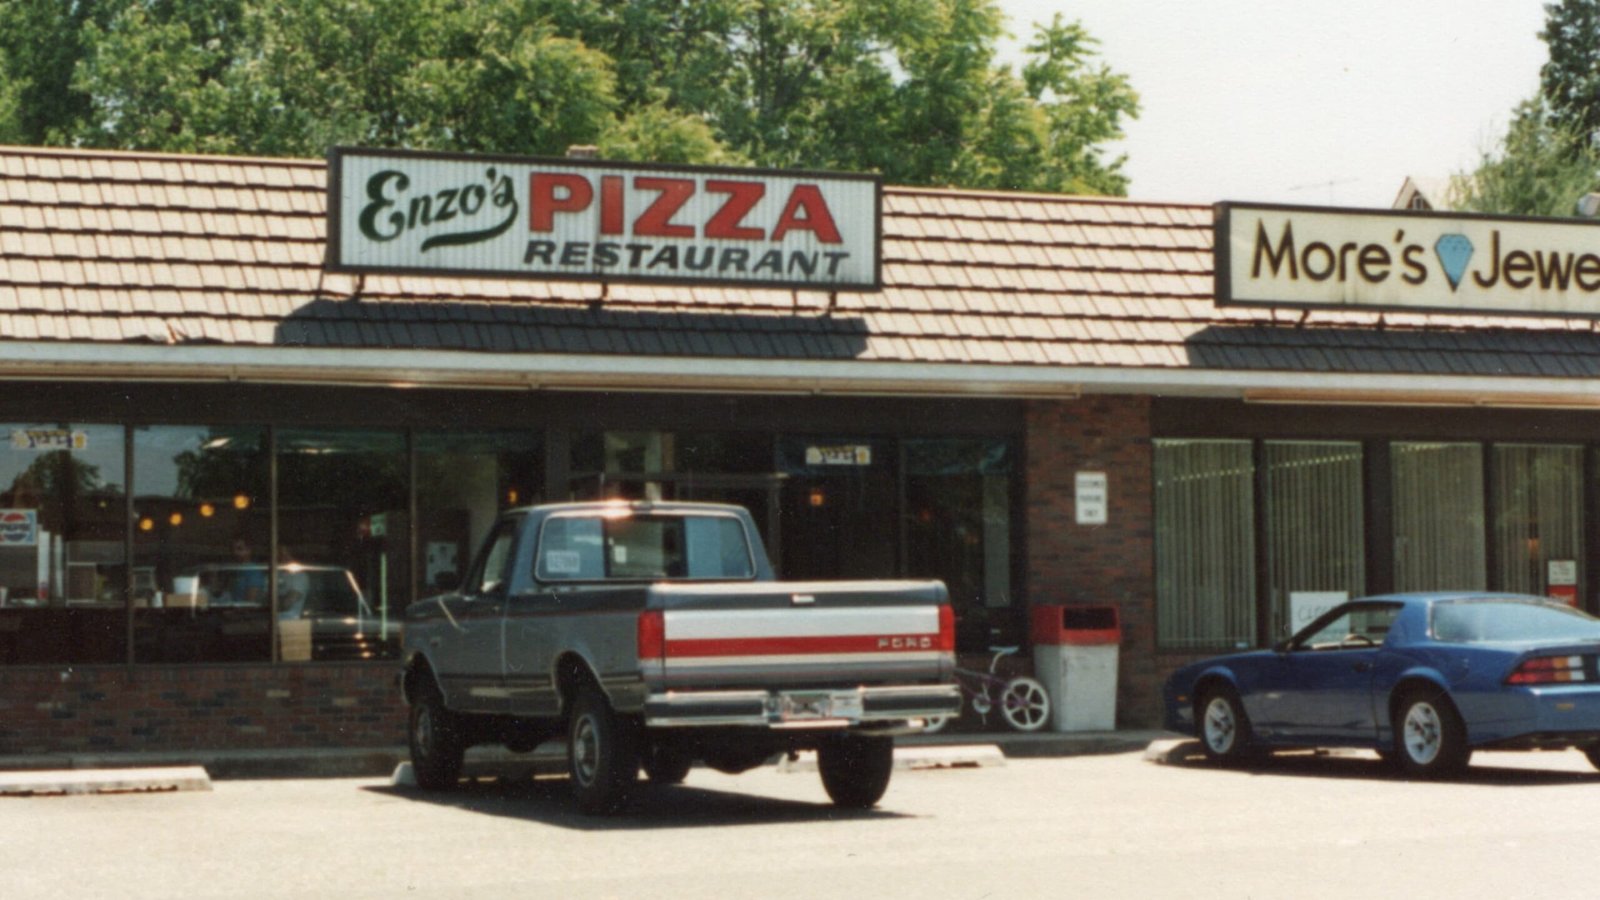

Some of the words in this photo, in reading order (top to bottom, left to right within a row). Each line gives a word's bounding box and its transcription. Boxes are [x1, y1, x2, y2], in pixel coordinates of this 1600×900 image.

[358, 167, 519, 253] Enzo's
[529, 171, 844, 244] PIZZA
[523, 239, 851, 277] RESTAURANT
[1252, 217, 1428, 286] More's
[878, 637, 932, 649] FORD
